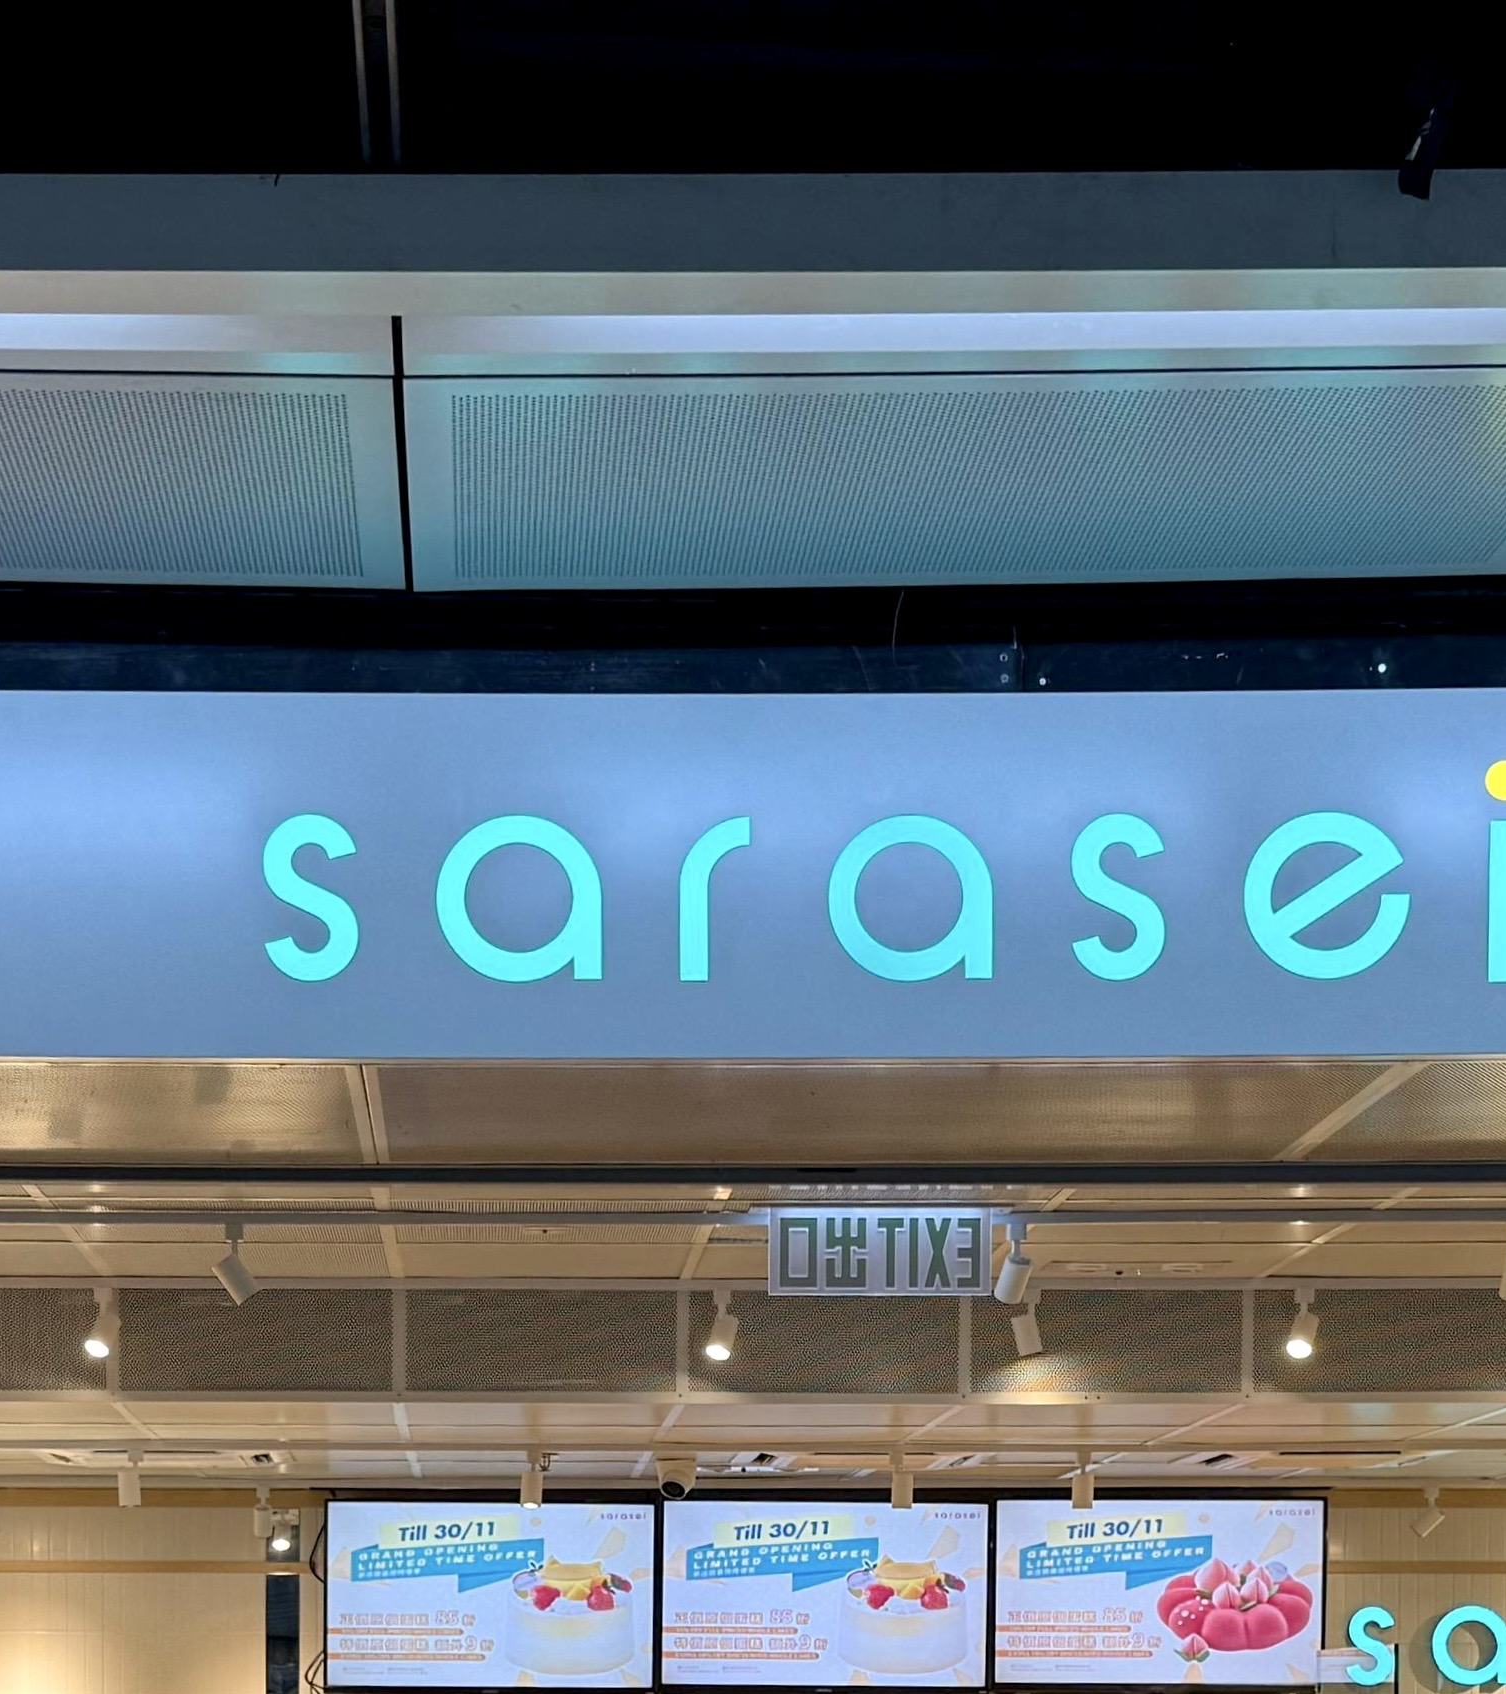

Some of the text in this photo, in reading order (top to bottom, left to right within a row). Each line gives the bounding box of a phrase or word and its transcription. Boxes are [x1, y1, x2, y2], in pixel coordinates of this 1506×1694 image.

[399, 1521, 495, 1541] Till 30/11
[734, 1520, 829, 1541] Till 30/11
[1067, 1518, 1163, 1540] Till 30/11
[359, 1543, 499, 1561] GRAND OPENING
[693, 1549, 871, 1570] LIMITED TIME OFFER
[694, 1542, 833, 1560] GRAND OPENING
[1026, 1547, 1205, 1569] LIMITED TIME OFFER
[1027, 1540, 1166, 1559] GRAND OPENING
[358, 1550, 537, 1571] LIMITED TIME OFFER
